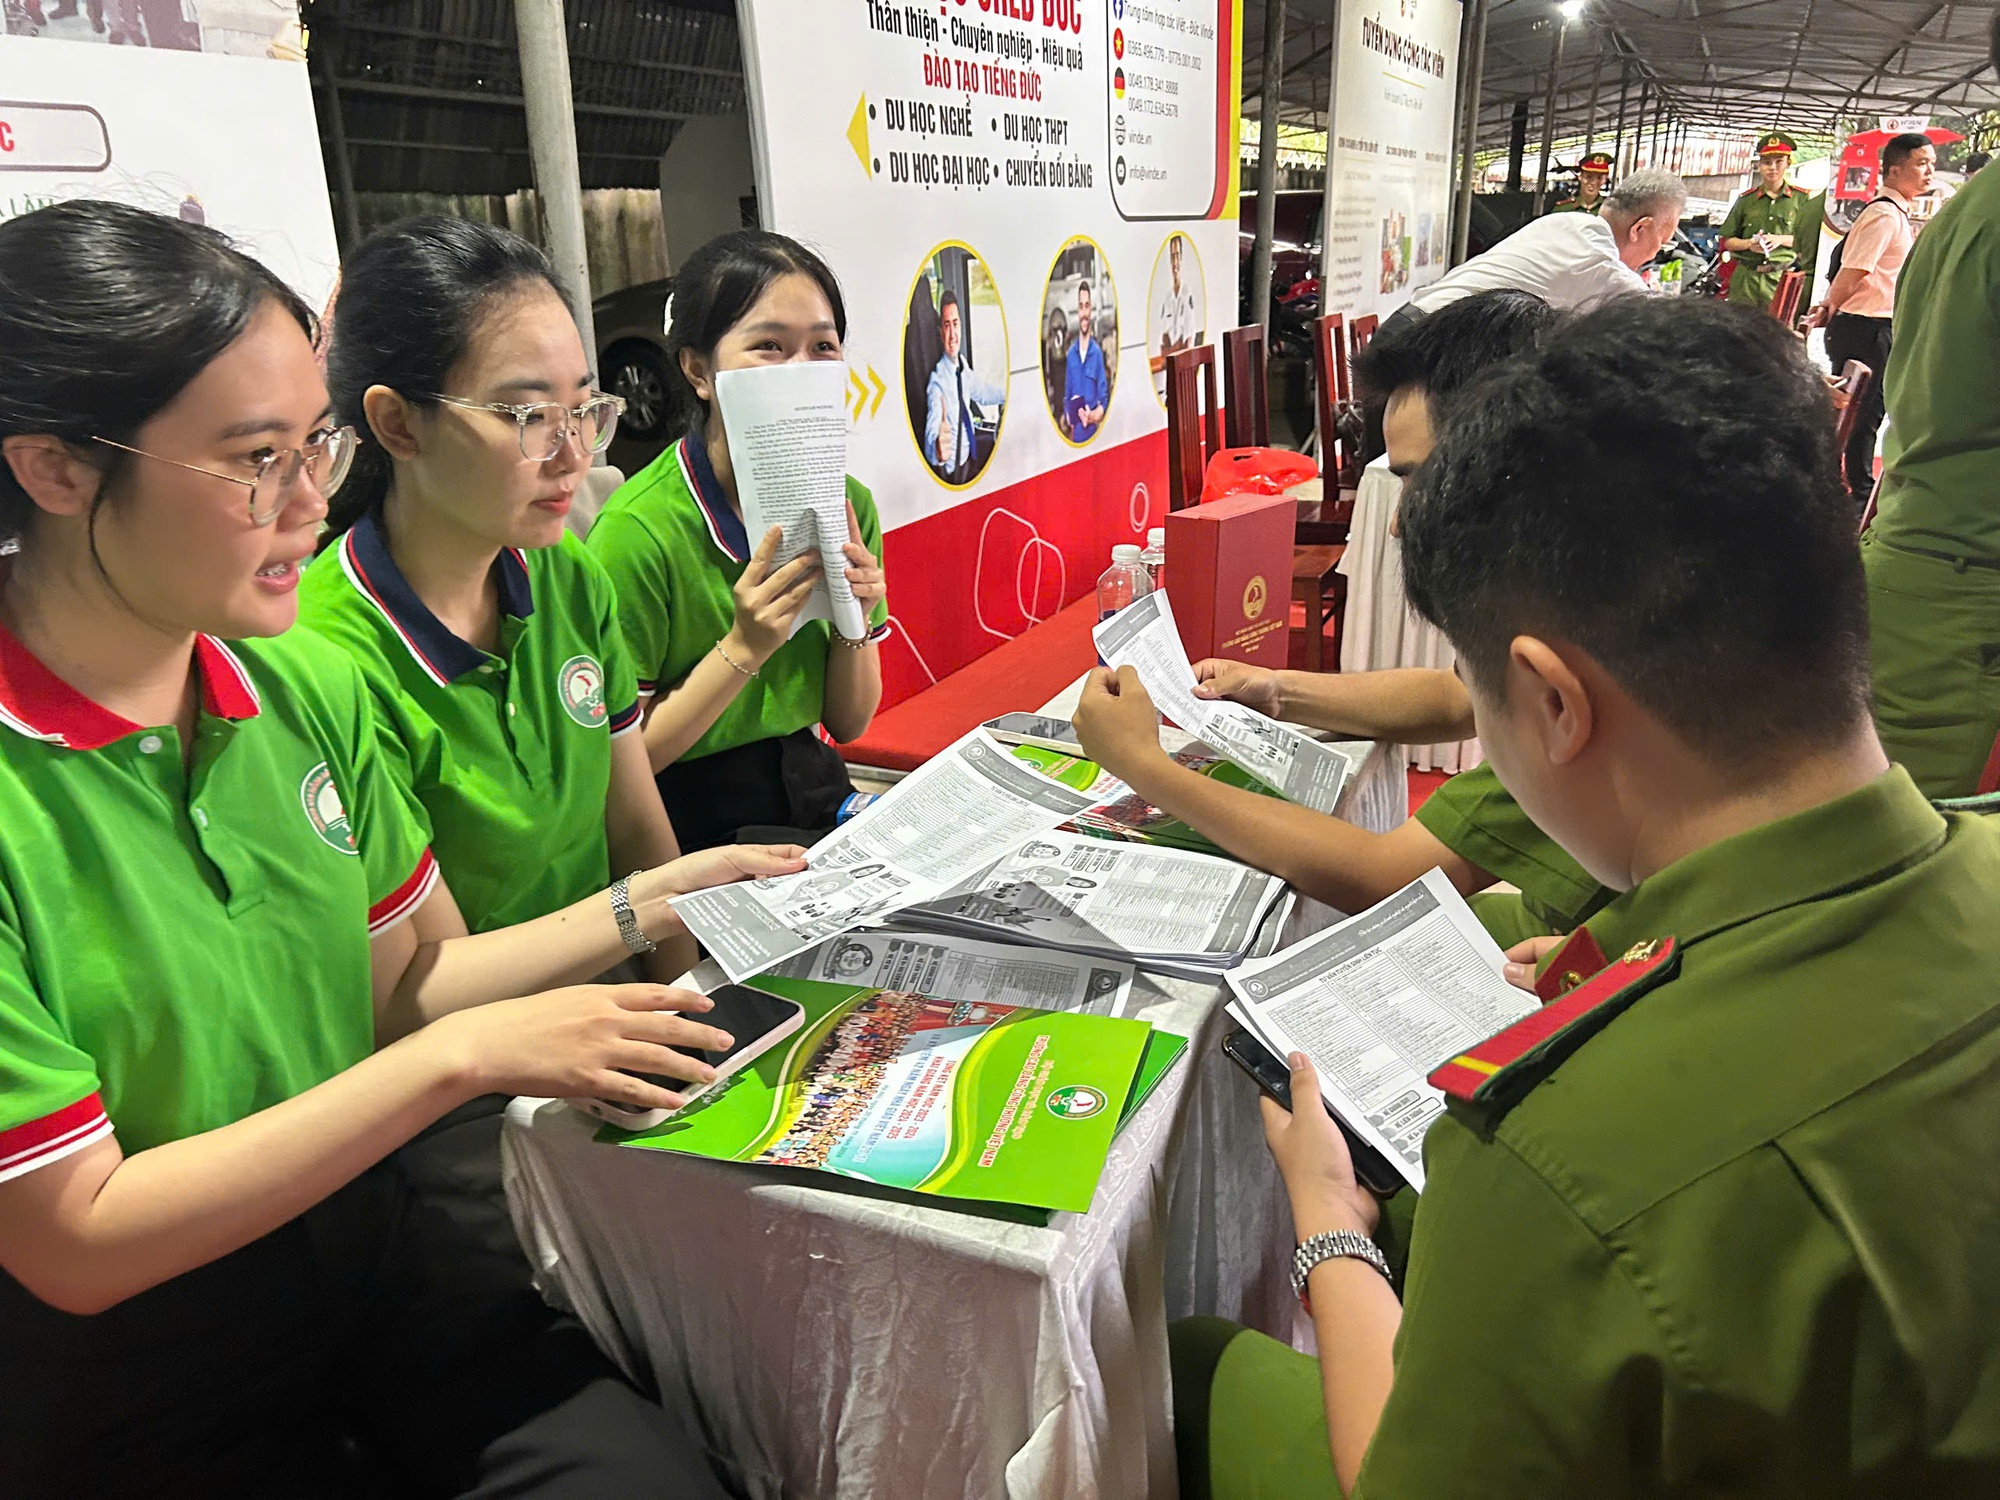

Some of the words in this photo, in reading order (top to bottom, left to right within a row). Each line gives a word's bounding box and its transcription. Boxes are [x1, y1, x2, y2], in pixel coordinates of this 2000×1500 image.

[867, 0, 901, 35] Thân
[905, 6, 939, 47] thiện
[951, 16, 993, 54] Chuyên
[997, 31, 1032, 66] nghiệp
[1042, 37, 1064, 71] Hiệu
[1066, 43, 1083, 72] quả
[1363, 11, 1383, 53] TUYỂN
[1385, 29, 1402, 65] DỤNG
[1403, 34, 1420, 72] CỘNG
[1421, 42, 1431, 73] TÁC
[1432, 49, 1445, 79] VIÊN
[923, 49, 951, 89] ĐÀO
[954, 59, 979, 98] TẠO
[982, 57, 1016, 98] TIẾNG
[1020, 67, 1042, 102] ĐỨC
[885, 99, 905, 131] DU
[909, 101, 936, 140] HỌC
[939, 98, 973, 137] NGHỀ
[1004, 113, 1018, 141] DU
[1021, 115, 1042, 149] HỌC
[1044, 118, 1068, 146] THPT
[890, 151, 909, 183] DU
[912, 152, 939, 191] HỌC
[942, 154, 964, 191] ĐẠI
[967, 156, 990, 192] HỌC
[1005, 149, 1047, 188] CHUYỂN
[1049, 152, 1065, 188] ĐỔI
[1068, 153, 1093, 189] BẰNG
[1023, 1058, 1039, 1069] CAO
[1007, 1088, 1025, 1106] CÔNG
[979, 1150, 997, 1166] NAM
[987, 1134, 1004, 1149] VIỆT
